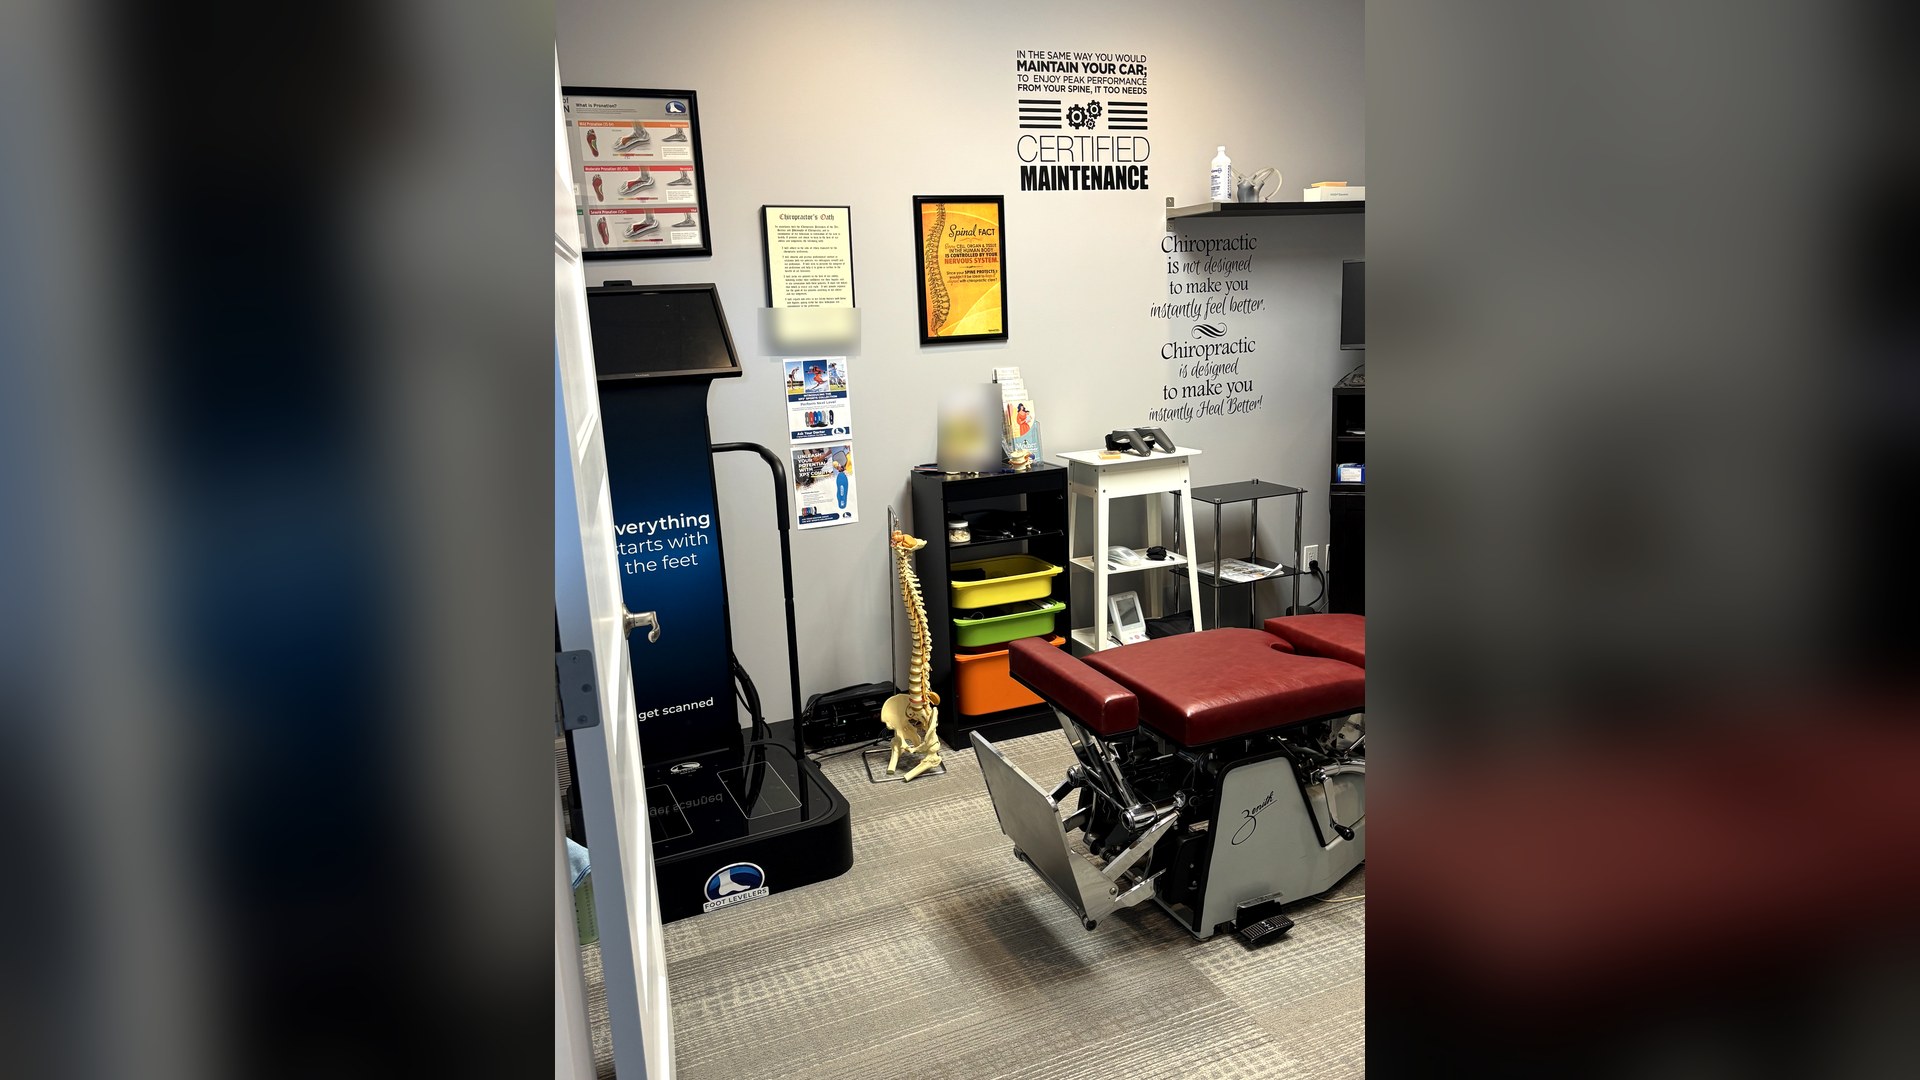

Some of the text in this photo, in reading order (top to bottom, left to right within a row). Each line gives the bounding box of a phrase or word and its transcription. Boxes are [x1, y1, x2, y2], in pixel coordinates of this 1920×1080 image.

[1017, 50, 1147, 63] IN THE SAME WAY YOU WOULD
[1016, 60, 1148, 77] MAINTAIN YOUR CAR;
[1017, 74, 1147, 86] TO ENJOY PEAK PERFORMANCE
[1017, 84, 1041, 92] FROM
[1043, 84, 1066, 93] YOUR
[1067, 85, 1093, 94] SPINE,
[1121, 86, 1148, 94] NEEDS
[1017, 134, 1151, 163] CERTIFIED
[1020, 165, 1149, 191] MAINTENANCE
[779, 213, 835, 221] Chiropractor's Oath
[948, 223, 995, 242] Spinal FACT
[1161, 233, 1257, 256] Chiropractic
[1167, 255, 1252, 277] is not designed
[1170, 278, 1249, 295] to make you
[1150, 296, 1266, 321] instantly feel better.
[1161, 336, 1256, 360] Chiropractic
[1179, 357, 1240, 380] is designed
[1163, 379, 1253, 400] to make you
[1149, 395, 1263, 423] instantly Heal Better!
[614, 513, 710, 535] verything
[667, 531, 708, 549] with
[625, 553, 699, 575] the feet
[638, 696, 714, 722] get scanned
[1231, 791, 1278, 845] Zenith
[704, 888, 767, 910] FOOT LEVELERS
